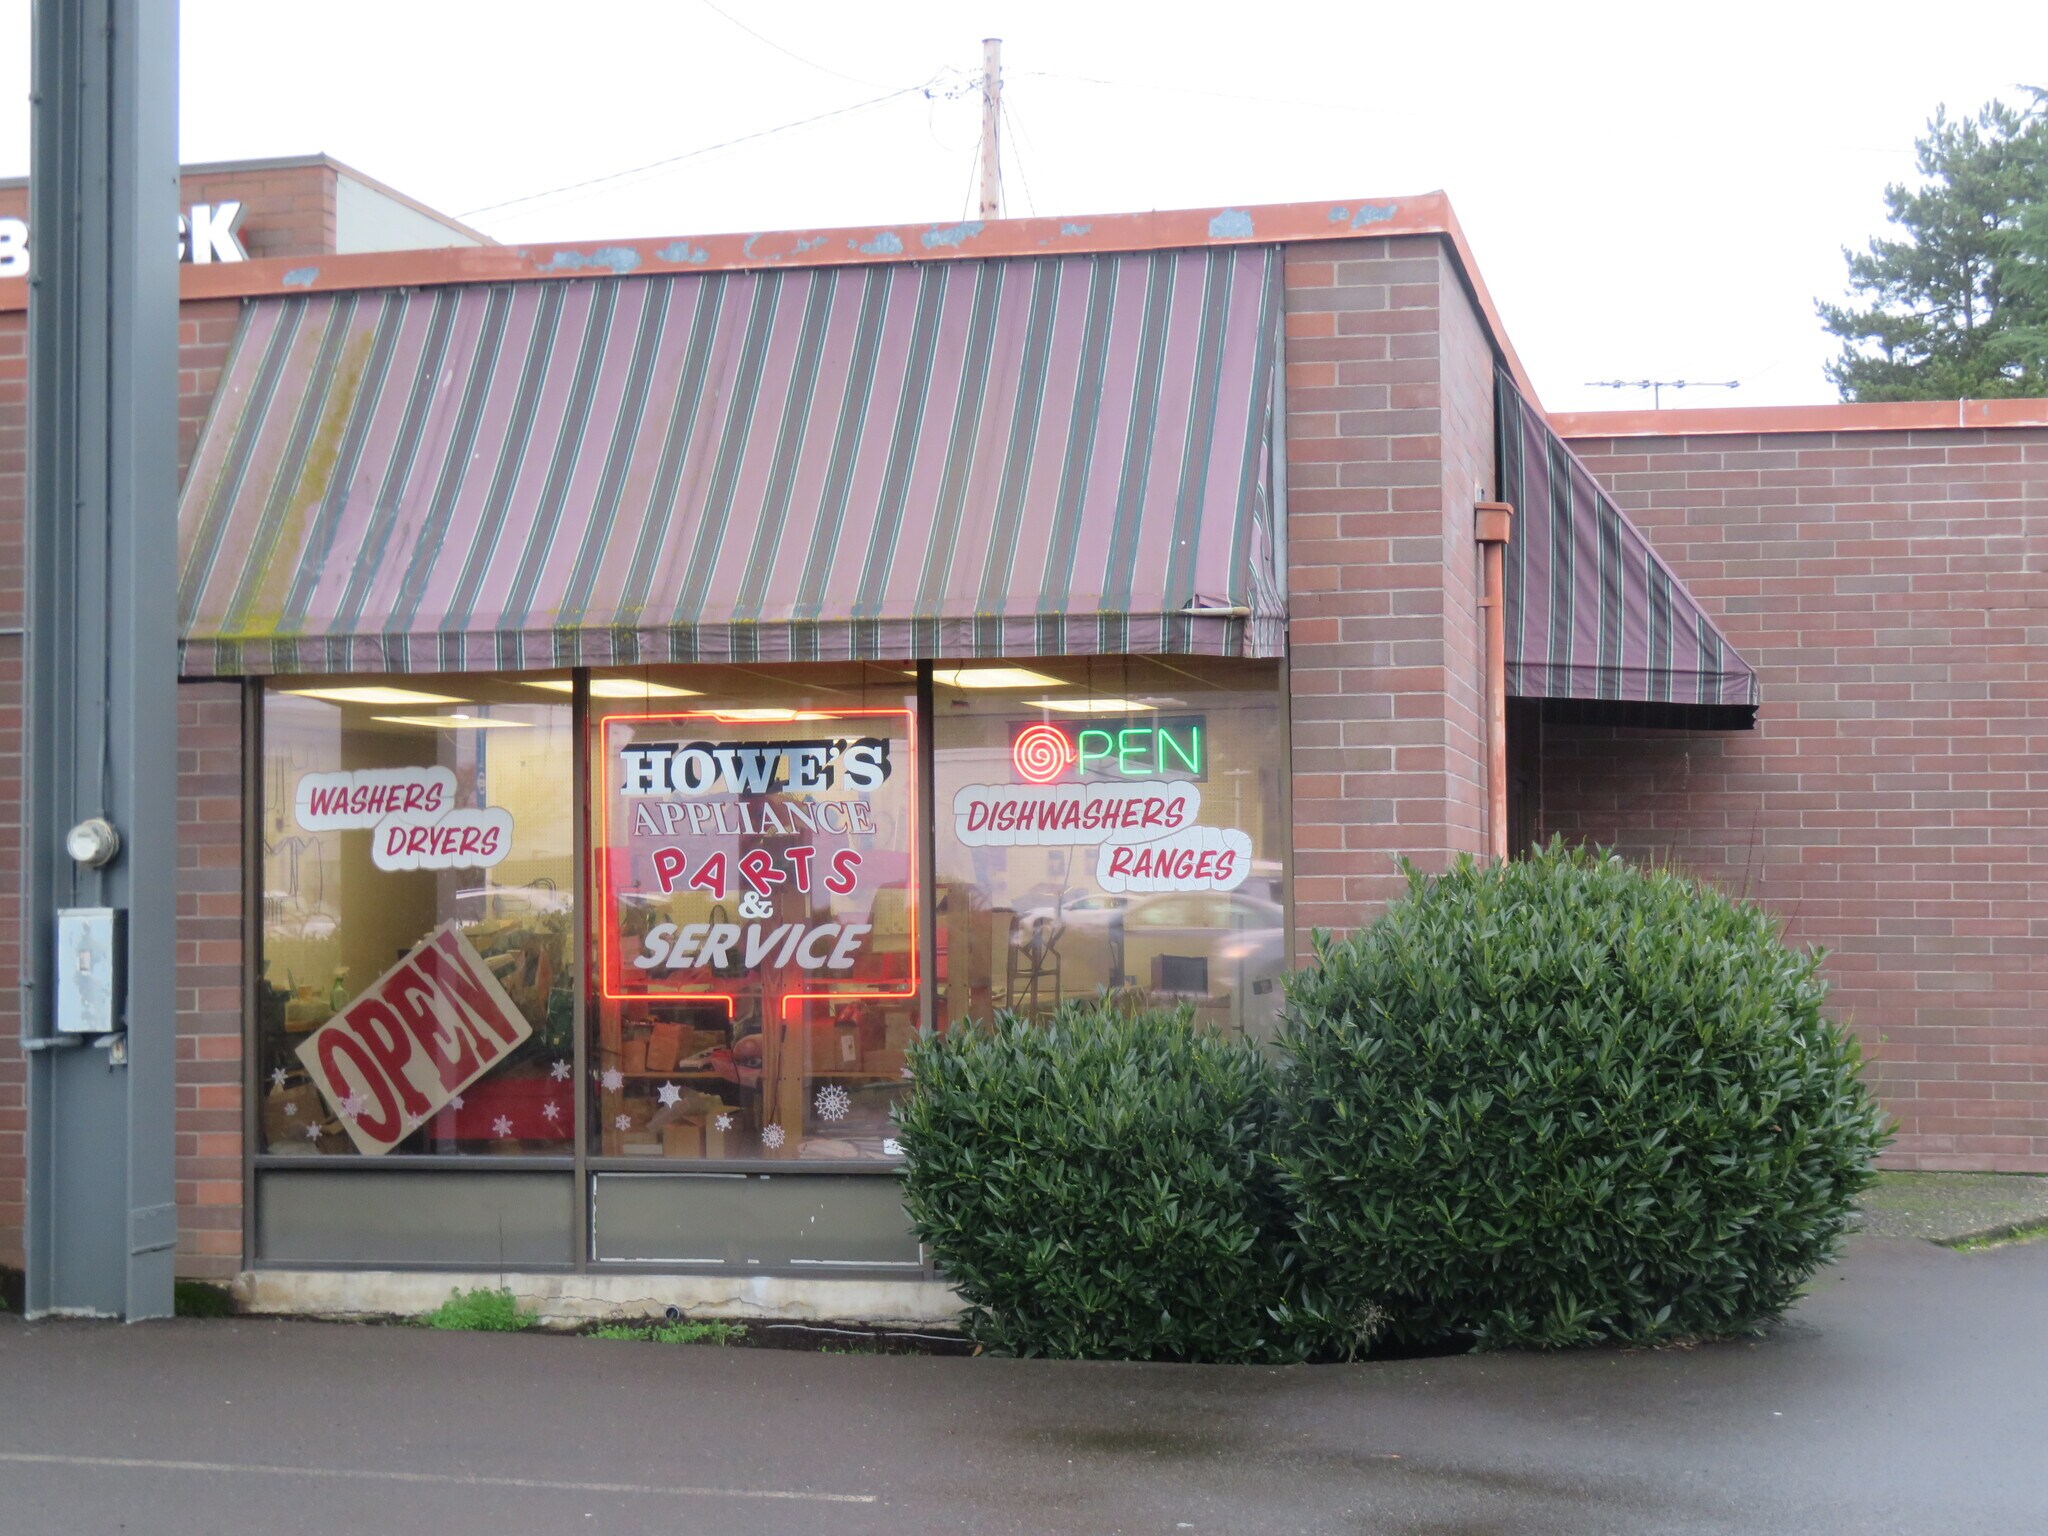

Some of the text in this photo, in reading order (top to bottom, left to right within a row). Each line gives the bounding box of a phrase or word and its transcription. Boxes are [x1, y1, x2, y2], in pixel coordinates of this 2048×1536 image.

[620, 737, 893, 795] HOWE'S
[1013, 725, 1200, 783] OPEN
[310, 782, 443, 816] WASHERS
[967, 797, 1186, 832] DISHWASHERS
[633, 800, 877, 836] APPLIANCE
[386, 826, 500, 856] DRYERS
[652, 846, 863, 899] PARTS
[1108, 847, 1236, 880] RANGES
[738, 891, 774, 918] &
[633, 923, 872, 969] SERVICE
[317, 929, 519, 1143] OPEN
